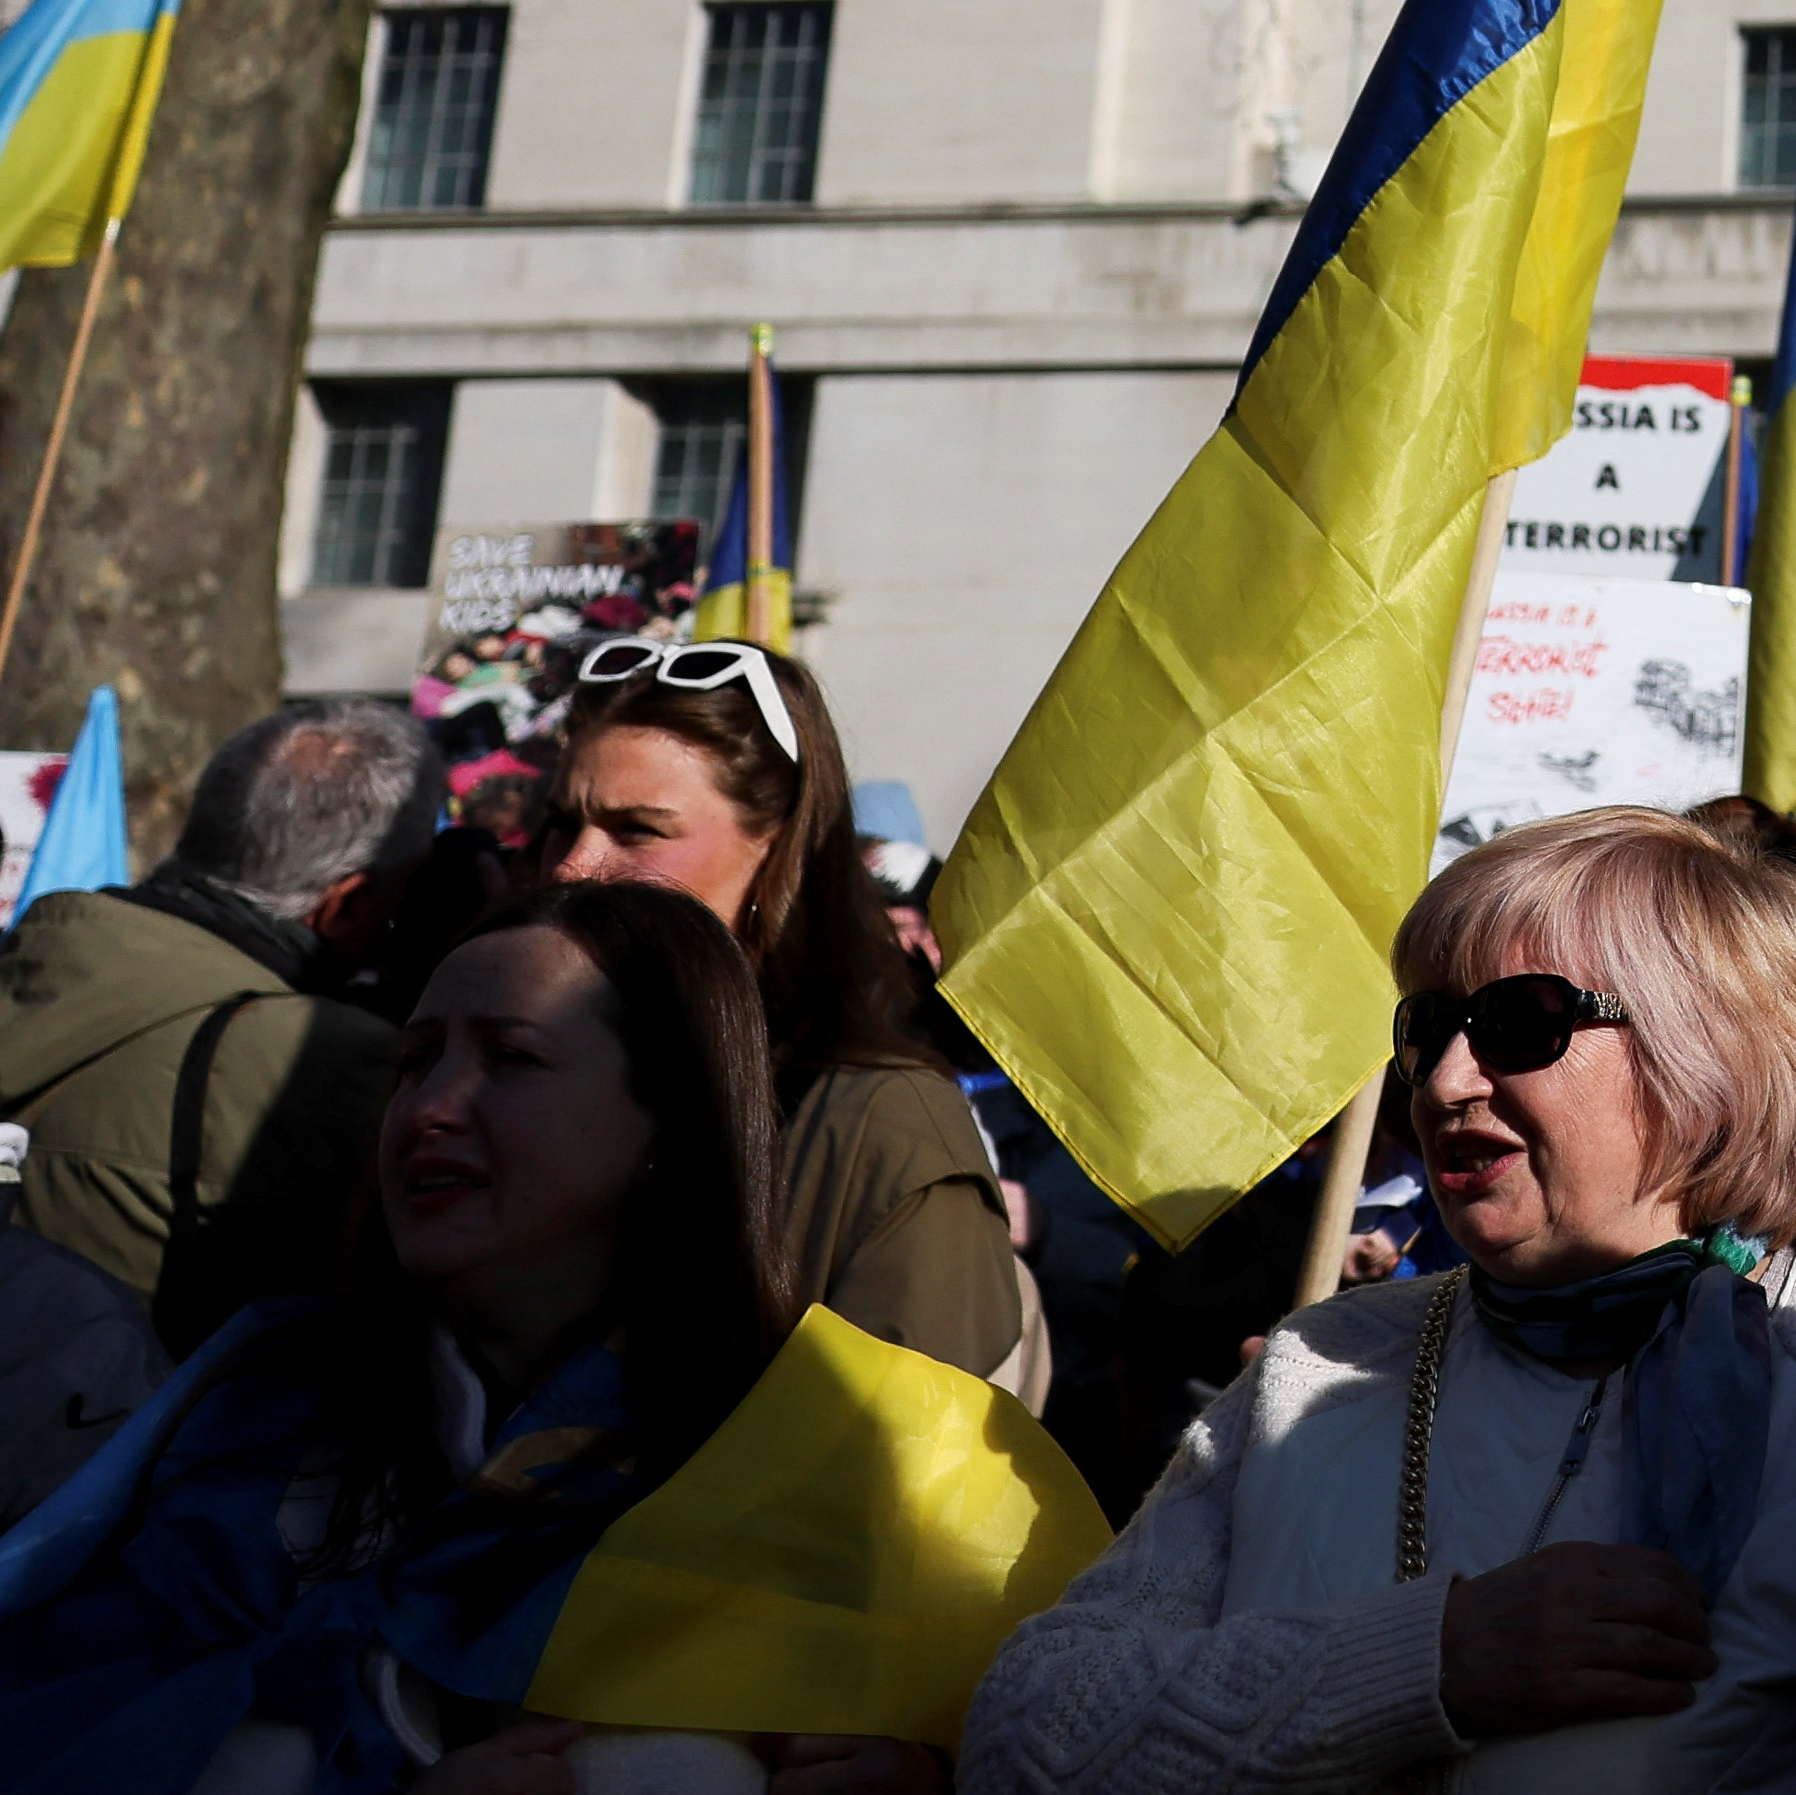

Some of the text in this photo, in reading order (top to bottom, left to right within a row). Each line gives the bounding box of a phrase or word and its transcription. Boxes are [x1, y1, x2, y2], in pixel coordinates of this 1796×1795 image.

[1577, 402, 1701, 433] SSIA IS
[1595, 464, 1619, 490] A
[450, 533, 534, 567] SAVE
[1506, 522, 1707, 555] TERRORIST
[444, 563, 626, 602] UKRAINIAN
[439, 598, 516, 634] KIDS
